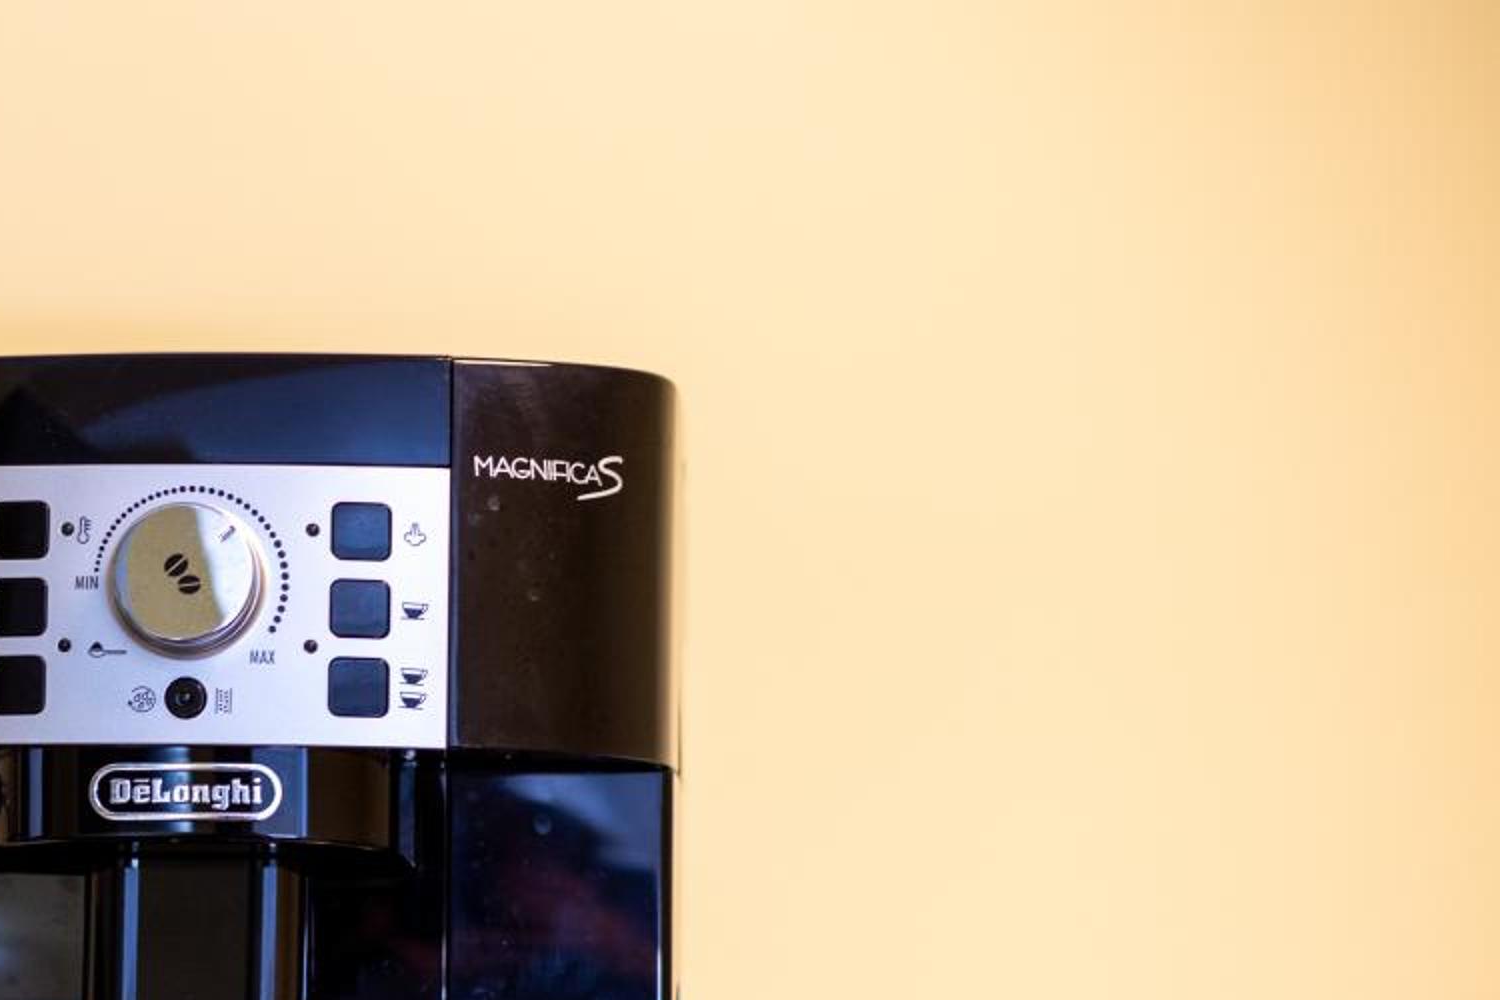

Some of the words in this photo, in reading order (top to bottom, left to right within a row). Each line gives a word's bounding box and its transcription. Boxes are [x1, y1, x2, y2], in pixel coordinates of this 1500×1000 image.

[473, 455, 603, 487] MAGNIFICA
[577, 455, 623, 501] S
[74, 575, 100, 590] MIN
[249, 649, 275, 665] MAX
